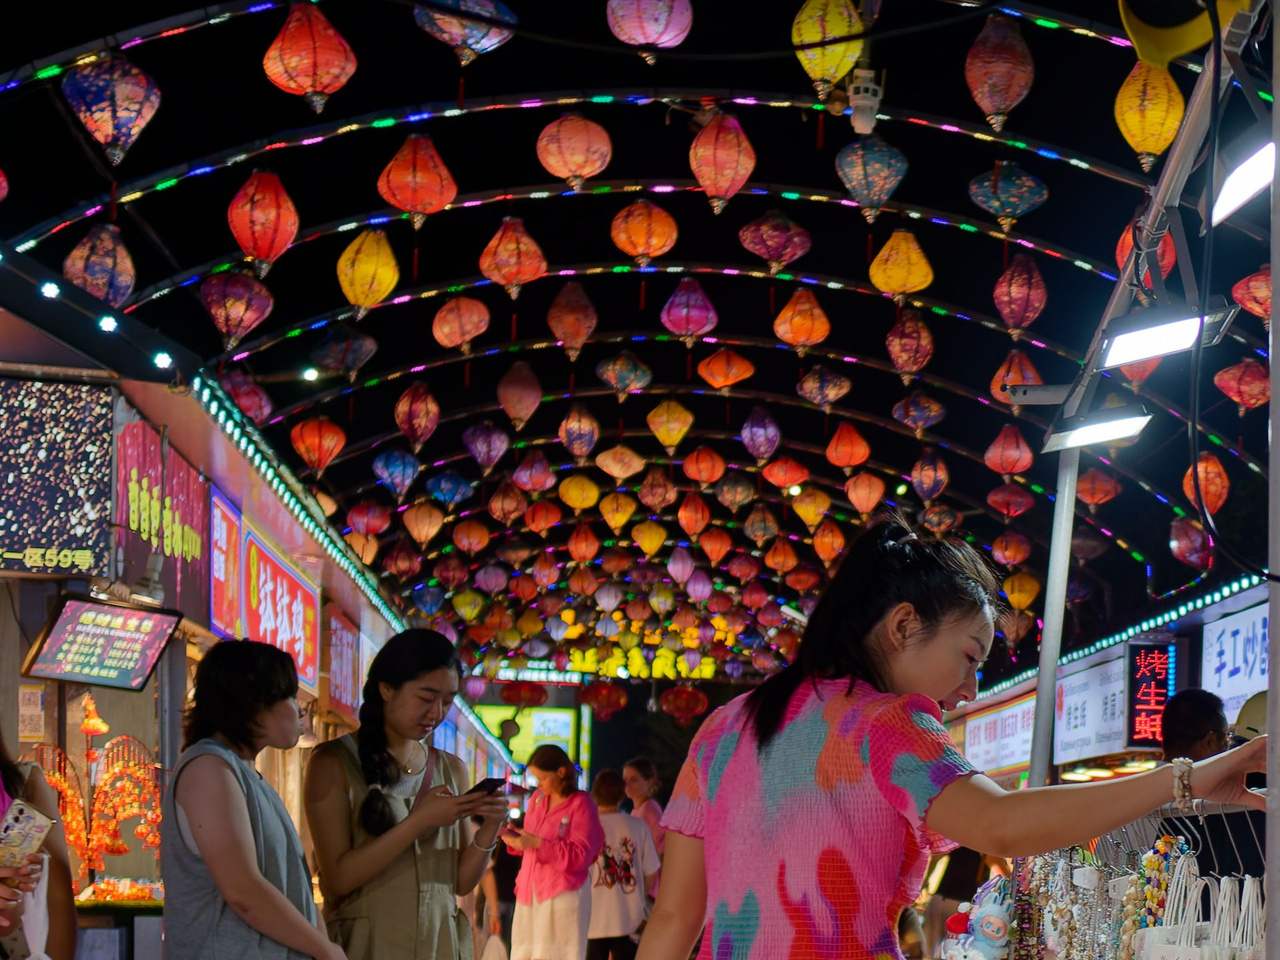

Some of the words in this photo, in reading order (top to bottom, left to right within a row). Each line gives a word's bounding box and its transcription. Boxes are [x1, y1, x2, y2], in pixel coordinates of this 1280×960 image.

[0, 548, 92, 570] 一区59号
[1133, 649, 1169, 741] 烤生蚝
